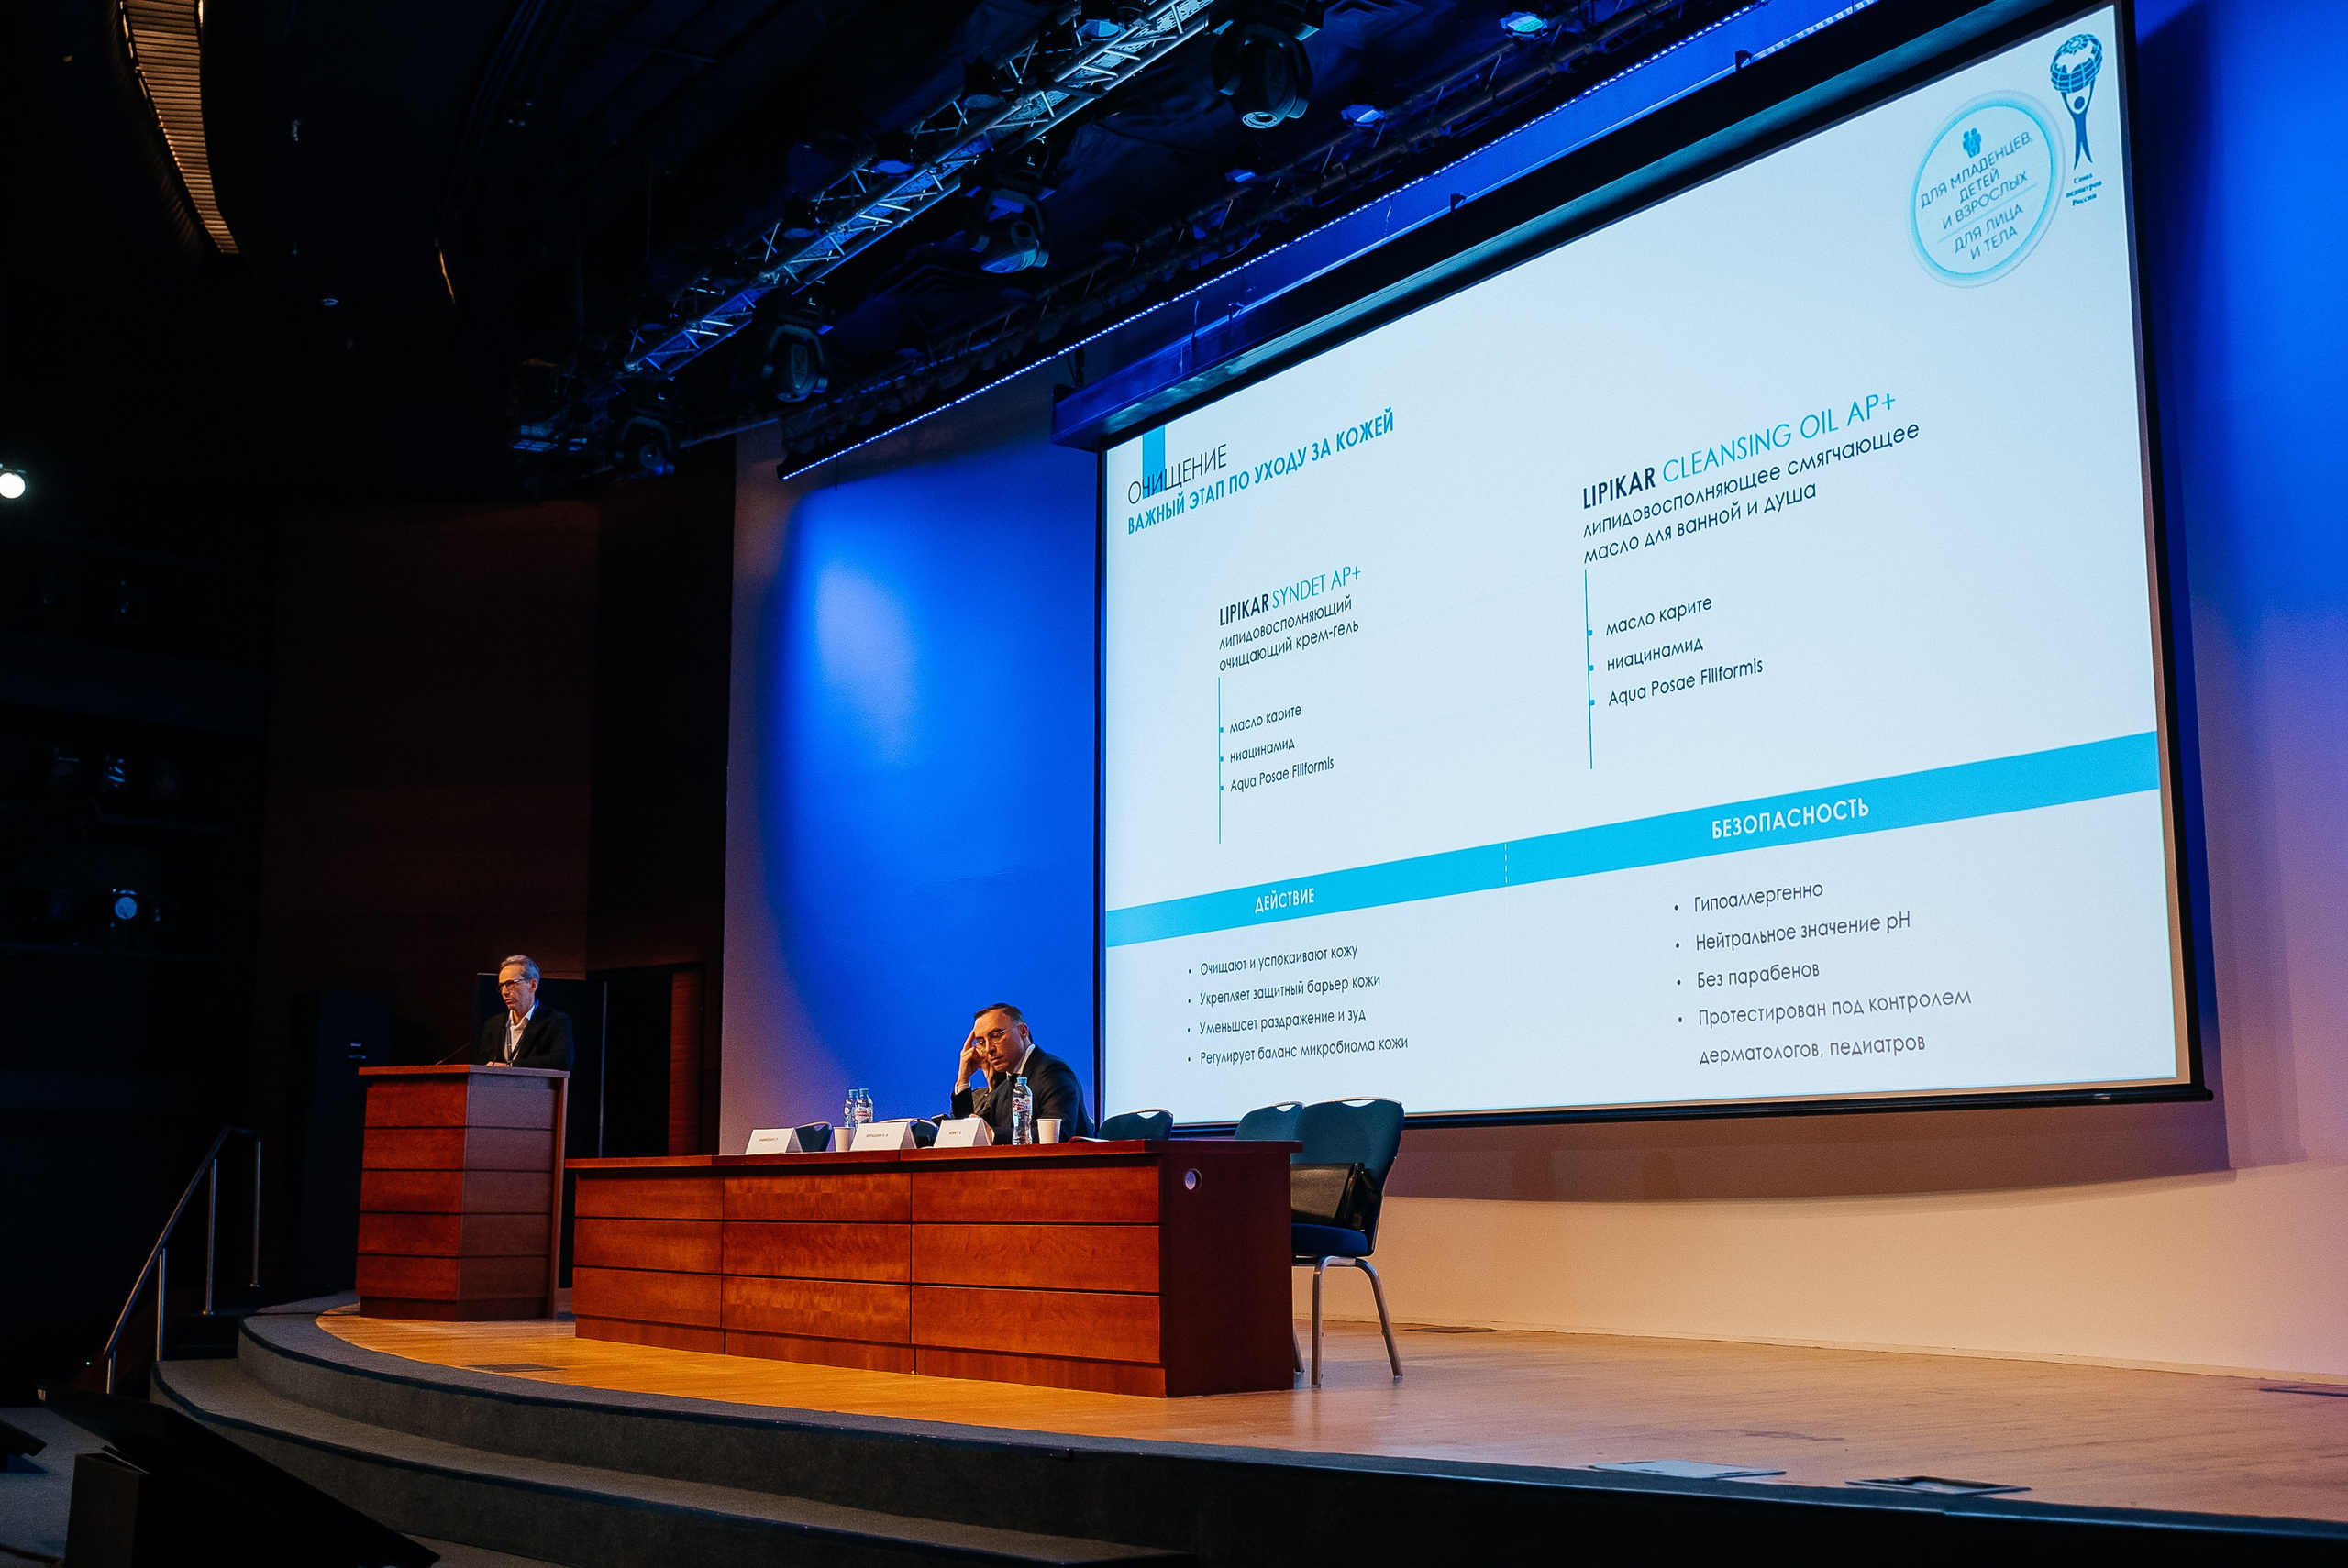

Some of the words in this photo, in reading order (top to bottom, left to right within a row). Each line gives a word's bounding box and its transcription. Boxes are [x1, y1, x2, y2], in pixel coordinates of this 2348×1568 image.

[1920, 182, 1948, 209] ДЛЯ
[1950, 131, 2034, 186] МЛАДЕНЦЕВ,
[1959, 168, 2000, 204] ДЕТЕЙ
[1943, 215, 1952, 229] И
[1955, 171, 2028, 223] ВЗРОСЛЫХ
[1955, 226, 1982, 254] ДЛЯ
[1987, 204, 2023, 234] ЛИЦА
[1970, 247, 1981, 259] И
[1984, 226, 2018, 252] ТЕЛА
[1583, 467, 1656, 509] LIPIKAR
[1663, 423, 1792, 483] CLEANSING
[1800, 408, 1839, 439] OIL
[1846, 393, 1896, 426] AP+
[1127, 492, 1185, 535] ВАЖНЫЙ
[1189, 479, 1224, 510] ЭТАП
[1228, 470, 1250, 495] ПО
[1254, 446, 1307, 485] УХОДУ
[1311, 438, 1331, 461] ЗА
[1335, 406, 1394, 452] КОЖЕЙ
[1128, 443, 1227, 504] ОЧИЩЕНИЕ
[1583, 465, 1781, 538] липидовосполняющее
[1787, 423, 1920, 476] смягчающее
[1584, 535, 1639, 564] масло
[1645, 525, 1672, 549] для
[1677, 502, 1742, 537] ванной
[1747, 502, 1758, 516] и
[1764, 482, 1817, 514] душа
[1220, 593, 1269, 626] LIPIKAR
[1272, 574, 1326, 609] SYNDET
[1331, 566, 1361, 591] AP+
[1219, 594, 1352, 650] липидовосполняющий
[1606, 612, 1655, 635] масло
[1659, 597, 1712, 623] карите
[1219, 636, 1292, 671] очищающий
[1296, 620, 1359, 650] крем-гель
[1607, 638, 1704, 671] ниацинамид
[1609, 684, 1647, 707] Aqua
[1651, 673, 1696, 697] Posae
[1230, 715, 1263, 734] масло
[1266, 705, 1302, 724] карите
[1230, 738, 1295, 763] ниацинамид
[1230, 776, 1257, 793] Aqua
[1259, 767, 1290, 786] Posae
[1711, 798, 1870, 839] БЕЗОПАСНОСТЬ
[1255, 888, 1315, 913] ДЕЙСТВИЕ
[1694, 882, 1823, 912] Гипоаллергенно
[1696, 925, 1797, 952] Нейтральное
[1800, 915, 1881, 940] значение
[1200, 958, 1247, 976] Очищают
[1249, 958, 1256, 969] и
[1258, 947, 1328, 971] успокаивают
[1331, 944, 1358, 960] кожу
[1697, 971, 1723, 988] Без
[1729, 961, 1820, 988] парабенов
[1199, 990, 1250, 1007] Укрепляет
[1253, 980, 1304, 999] защитный
[1307, 978, 1349, 996] барьер
[1352, 975, 1380, 988] кожи
[1698, 1001, 1827, 1029] Протестирован
[1833, 1000, 1865, 1017] под
[1869, 989, 1972, 1013] контролем
[1199, 1018, 1257, 1035] Уменьшает
[1260, 1010, 1335, 1032] раздражение
[1338, 1010, 1345, 1021] и
[1347, 1008, 1367, 1024] зуд
[1200, 1048, 1255, 1066] Регулирует
[1257, 1045, 1298, 1060] баланс
[1301, 1039, 1375, 1062] микробиома
[1379, 1036, 1409, 1050] кожи
[1700, 1043, 1824, 1066] дерматологов,
[1830, 1034, 1926, 1056] педиатров
